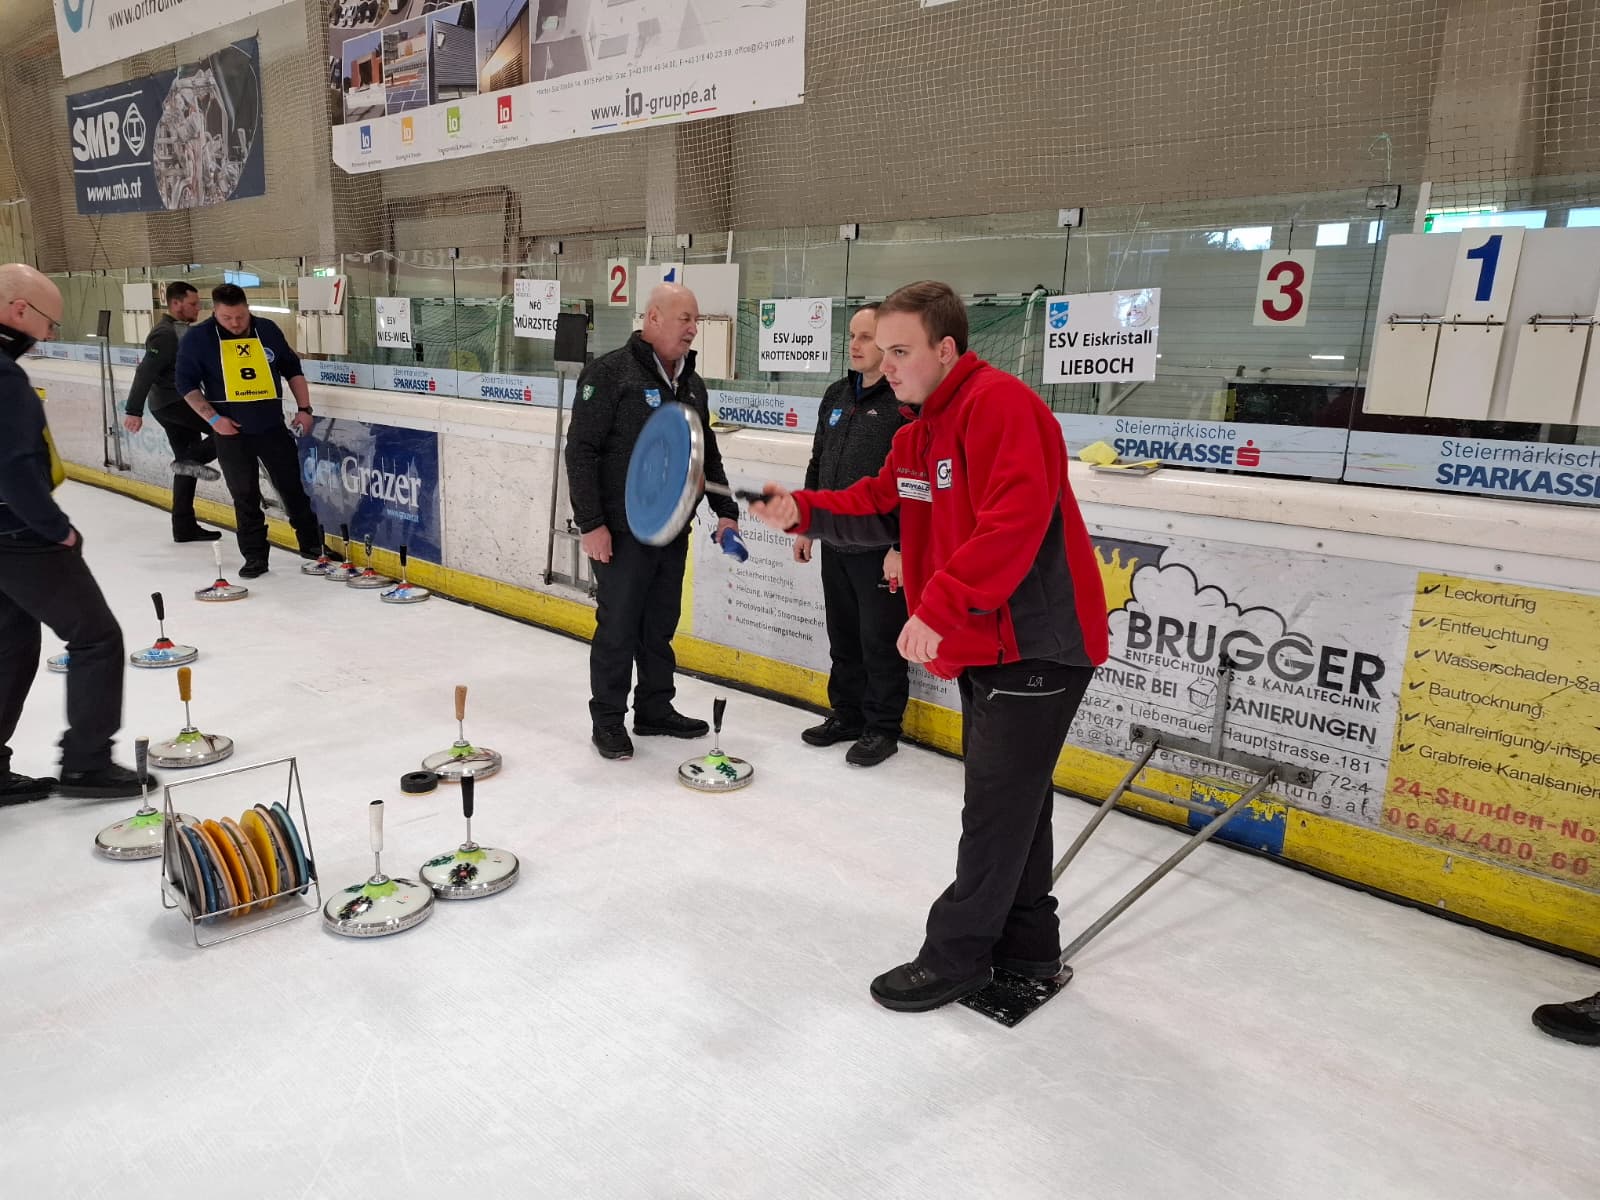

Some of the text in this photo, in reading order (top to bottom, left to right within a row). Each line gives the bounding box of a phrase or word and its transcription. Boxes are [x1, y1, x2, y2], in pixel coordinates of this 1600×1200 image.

[72, 111, 120, 161] SMB
[87, 176, 142, 201] www.smb.at
[1466, 235, 1503, 301] 1
[333, 278, 341, 305] 1
[610, 265, 627, 302] 2
[1262, 261, 1305, 321] 3
[773, 332, 814, 346] ESV Jupp
[1049, 330, 1152, 348] ESV Eiskristall
[761, 350, 820, 361] KROTTENDORF
[1060, 357, 1134, 375] LIEBOCH
[240, 368, 257, 380] 8
[320, 371, 350, 384] SPARKASSE
[393, 378, 429, 391] SPARKASSE
[481, 386, 523, 400] SPARKASSE
[720, 392, 785, 408] Steiermärkische
[718, 407, 784, 426] SPARKASSE
[1115, 419, 1236, 440] Steiermärkische
[1113, 438, 1234, 465] SPARKASSE
[341, 456, 421, 508] Grazer
[1444, 585, 1537, 614] Leckortung
[1439, 618, 1549, 650] Entfeuchtung
[1126, 611, 1386, 700] BRUGGER
[1094, 666, 1178, 699] RTNER BEI
[1125, 649, 1382, 714] ENTFEUCHTUNS- & KANALTECHNIK
[1428, 682, 1543, 720] Bautrocknung
[1130, 703, 1214, 735] Liebenauer
[1223, 727, 1331, 765] Hauptstrasse
[1419, 745, 1493, 774] Grabfreie
[1386, 807, 1590, 876] 0664/400 60
